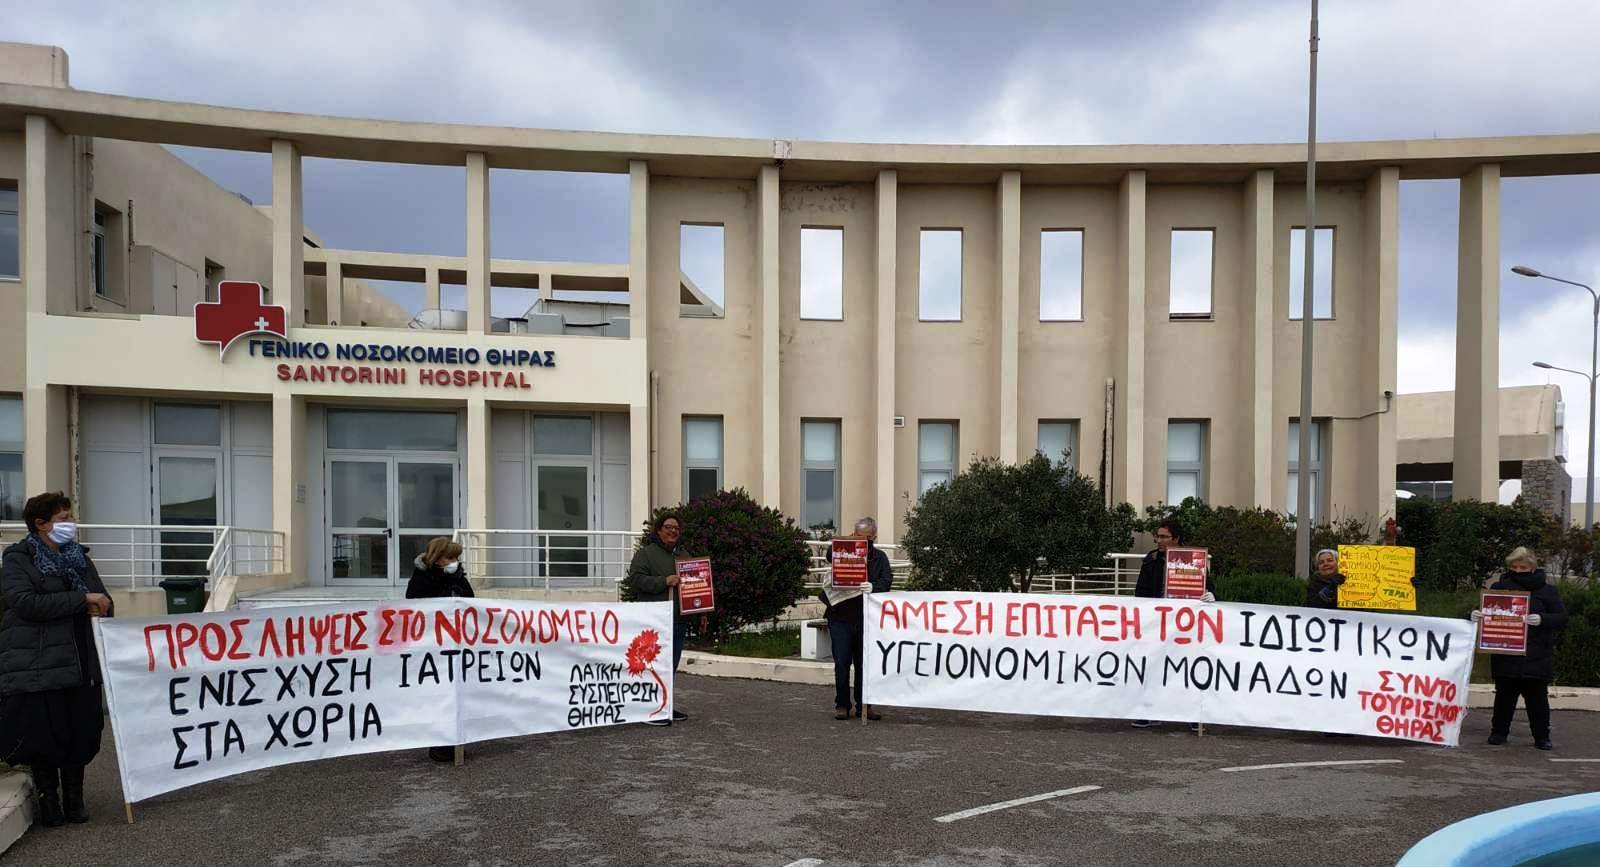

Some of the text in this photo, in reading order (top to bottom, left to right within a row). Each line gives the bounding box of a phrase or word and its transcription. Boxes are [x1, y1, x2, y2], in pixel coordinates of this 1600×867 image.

[248, 339, 556, 367] ΓΕΝΙΚΟ ΝΟΣΟΚΟΜΕΙΟ ΘΗΡΑΣ
[278, 363, 531, 389] SANTORINI HOSPITAL
[143, 607, 618, 672] ΠΡΟΣΛΗΨΕΙΣ ΣΤΟ ΝΟΣΟΚΟΜΕΙΟ
[878, 599, 994, 636] ΑΜΕΣΗ
[1005, 602, 1141, 642] ΕΠΙΤΑΞΗ
[1154, 606, 1224, 646] ΤΩΝ
[1240, 611, 1451, 661] ΙΔΙΩΤΙΚΩΝ
[169, 649, 541, 715] ΕΝΙΣΧΥΣΗ ΙΑΤΡΕΙΩΝ
[876, 640, 1346, 699] ΥΓΕΙΟΝΟΜΙΚΩΝ ΜΟΝΑΔΩΝ
[569, 682, 659, 705] ΣΥΣΠΕΙΡΩΣΗ
[172, 702, 382, 770] ΣΤΑ ΧΩΡΙΑ
[567, 704, 627, 727] ΘΗΡΑΣ
[1376, 715, 1446, 742] ΘΗΡΑΣ
